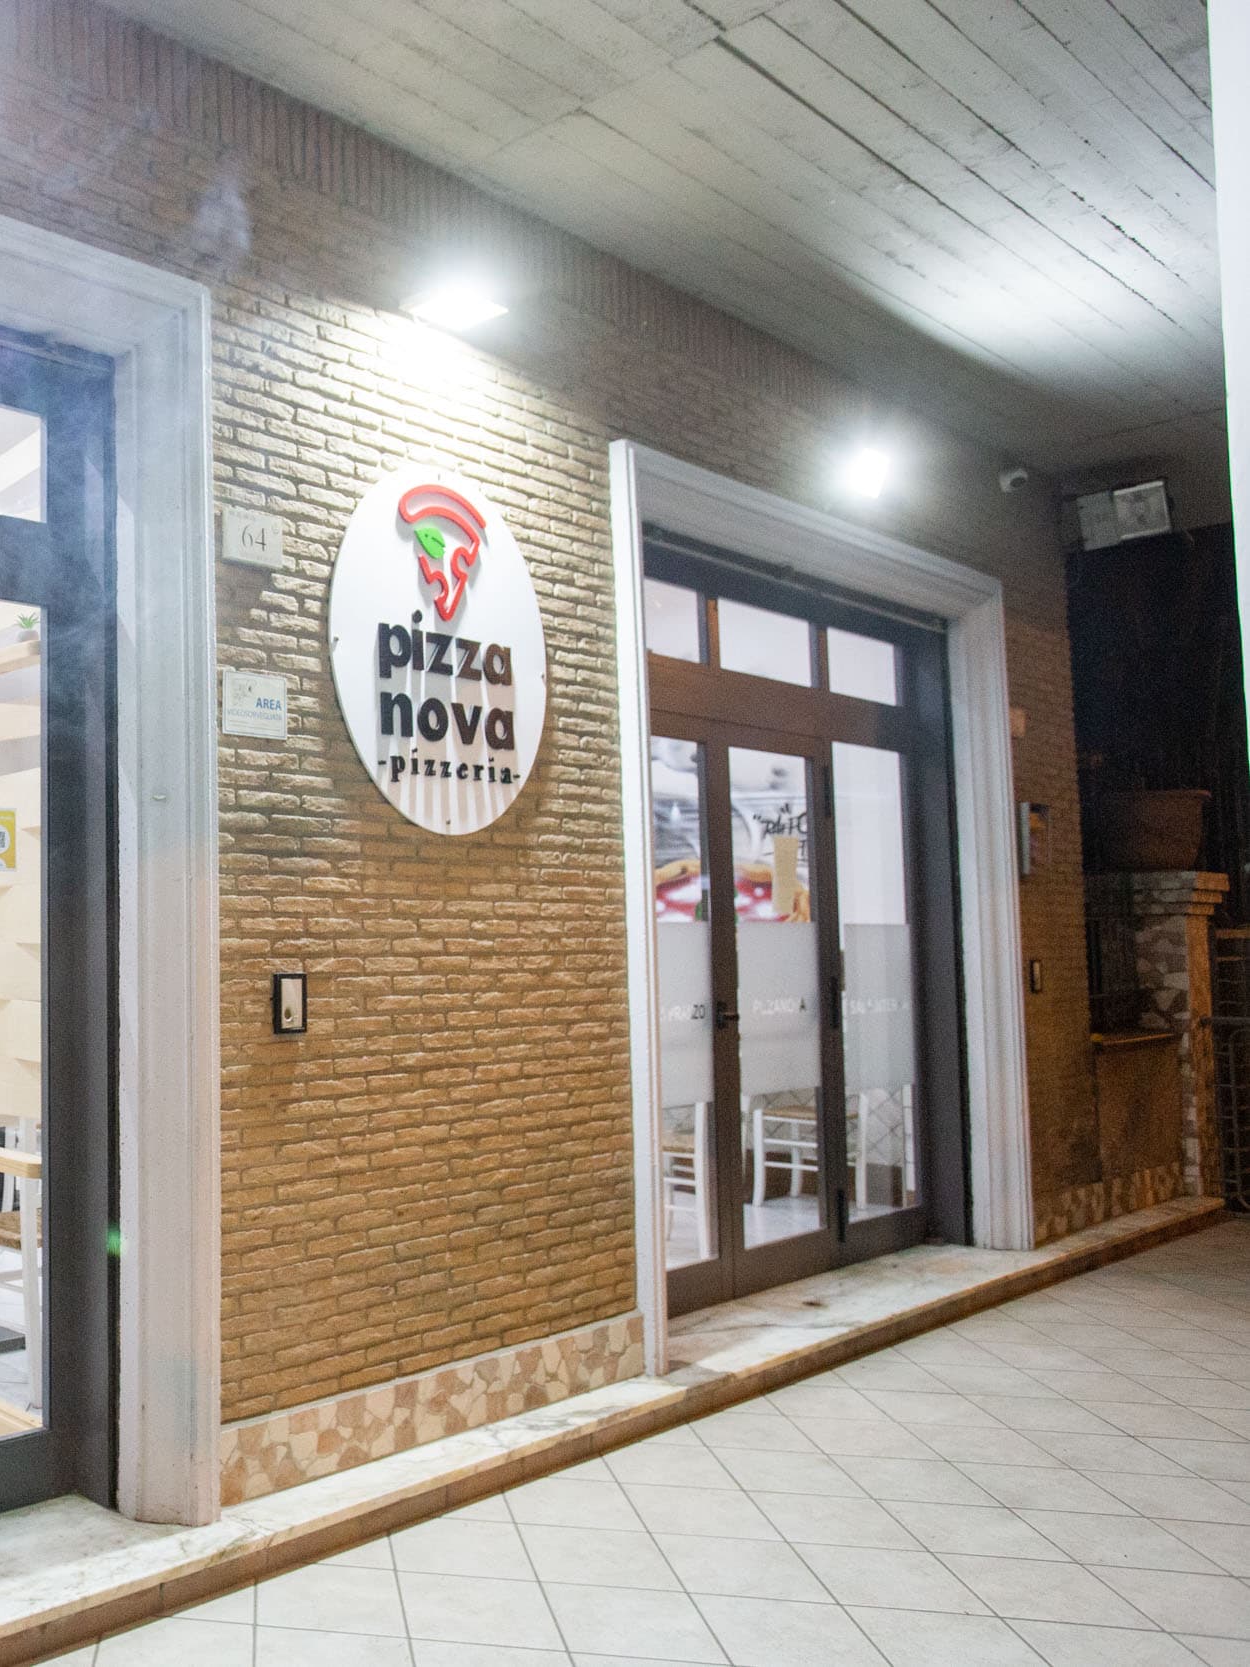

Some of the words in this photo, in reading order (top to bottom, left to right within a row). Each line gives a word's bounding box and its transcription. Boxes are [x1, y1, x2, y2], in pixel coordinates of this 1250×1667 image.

[241, 524, 267, 552] 64
[378, 609, 512, 686] pizza
[255, 697, 282, 711] AREA
[380, 691, 515, 750] nova
